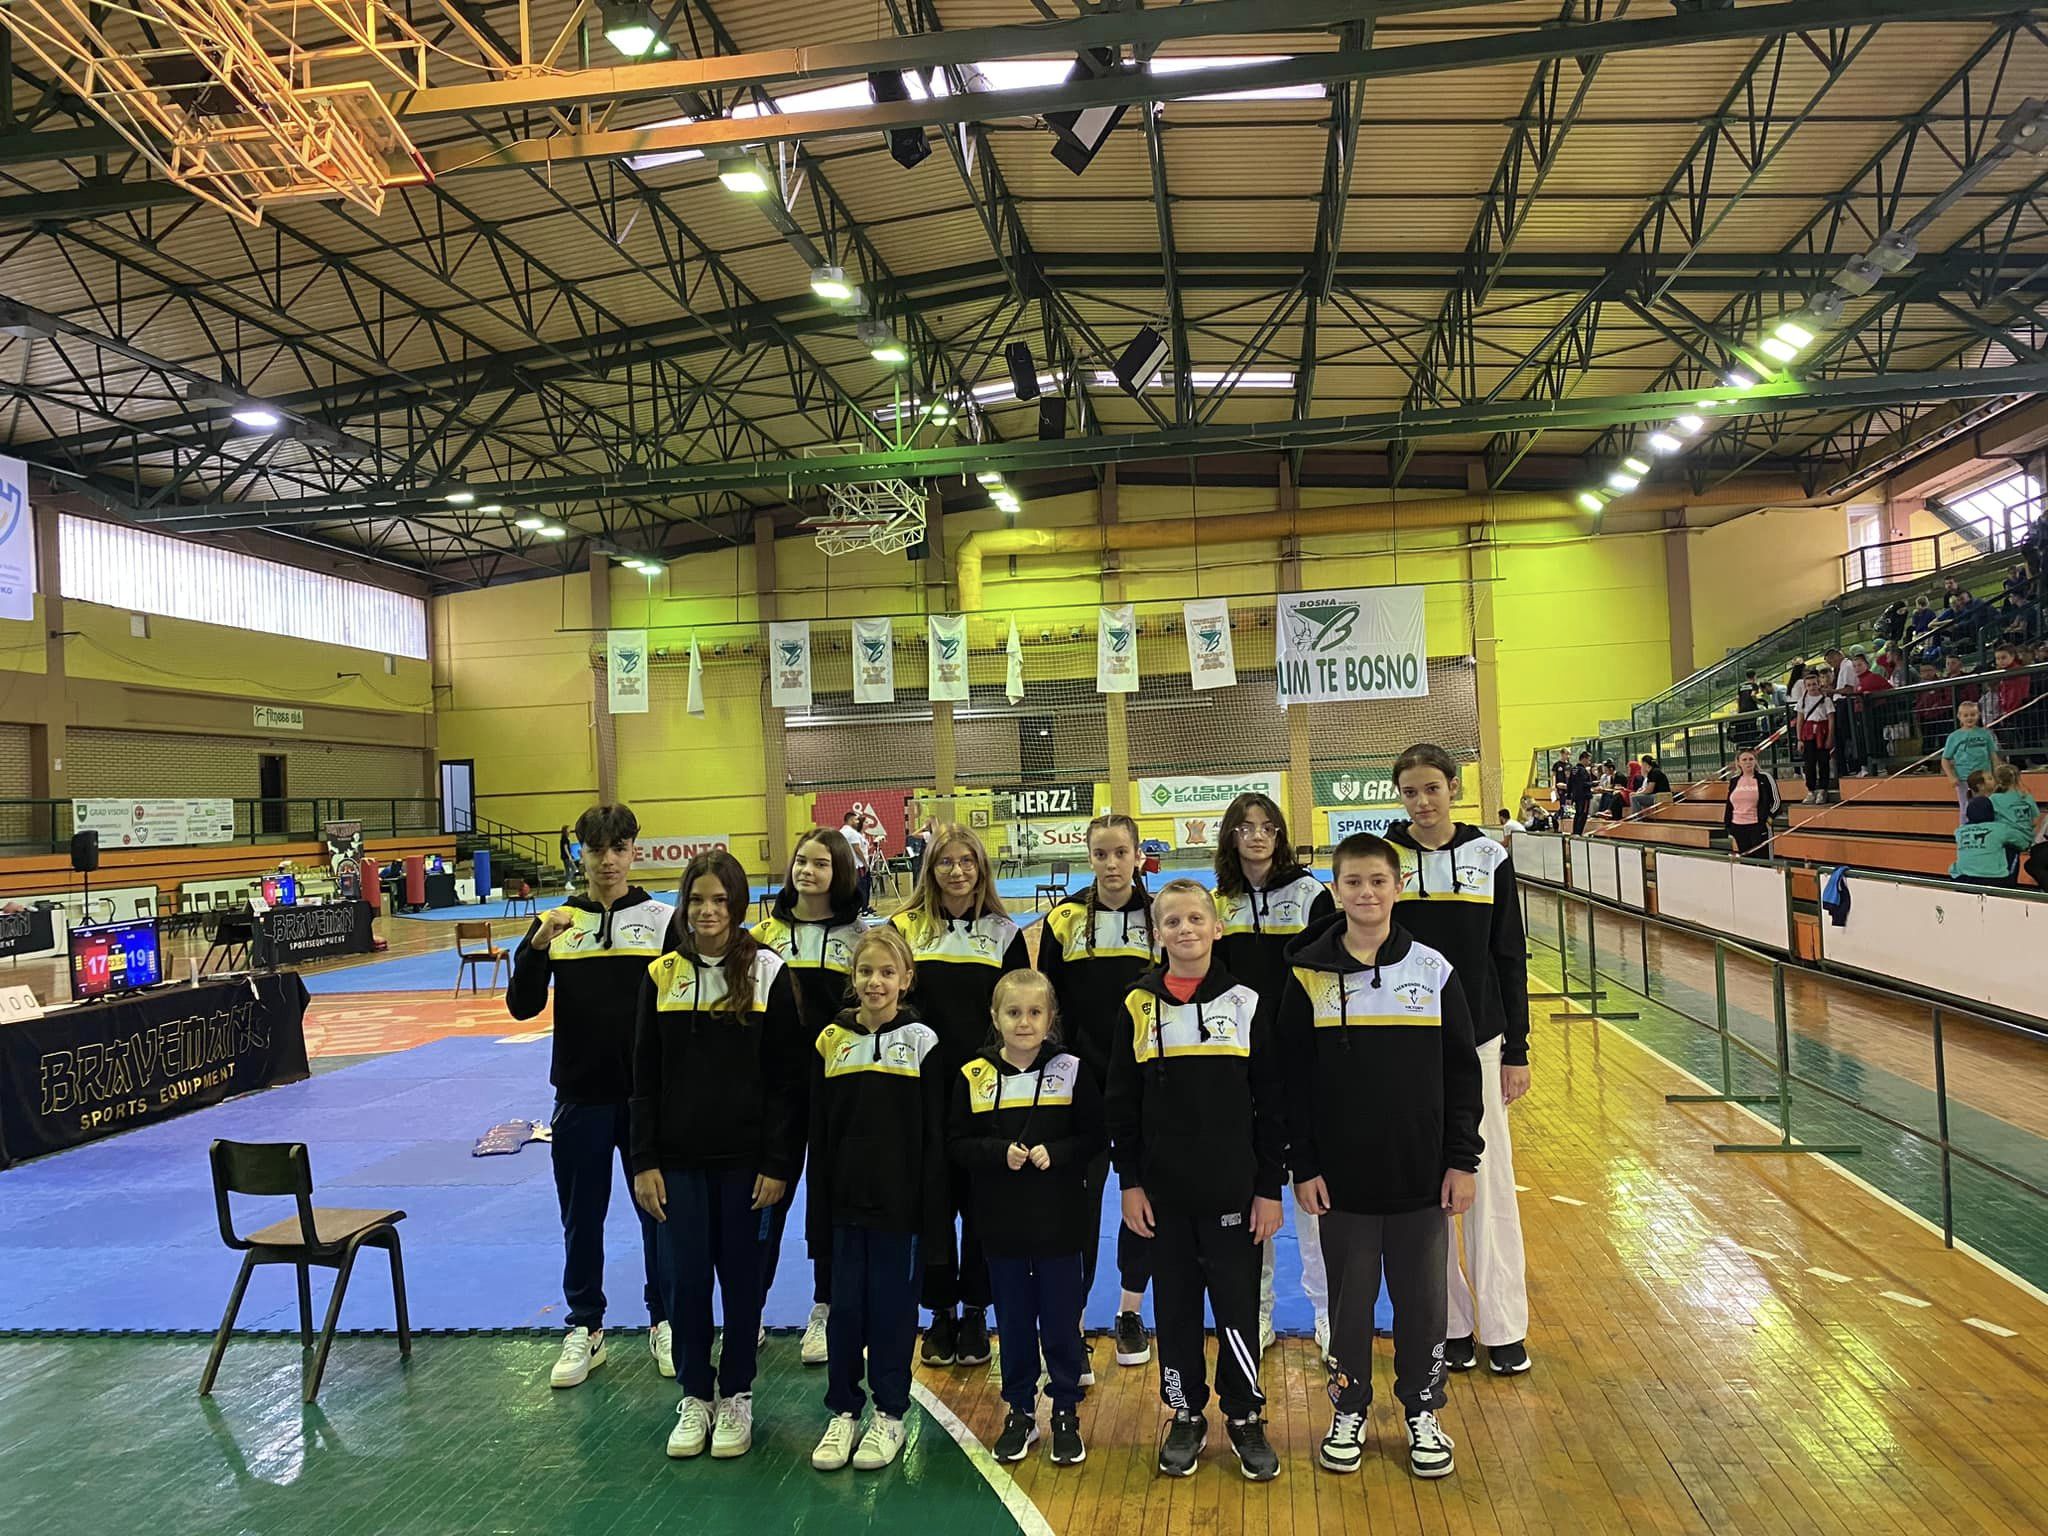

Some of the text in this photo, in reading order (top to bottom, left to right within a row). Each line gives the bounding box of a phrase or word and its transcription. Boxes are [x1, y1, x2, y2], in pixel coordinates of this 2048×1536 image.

[1299, 598, 1337, 608] BOSNA
[1316, 658, 1338, 693] TE
[1345, 652, 1418, 691] BOSNO
[1174, 782, 1270, 795] VISOKO
[88, 954, 108, 975] 17
[128, 949, 146, 968] 19
[80, 1062, 236, 1131] SPORTS EQUIPMENT
